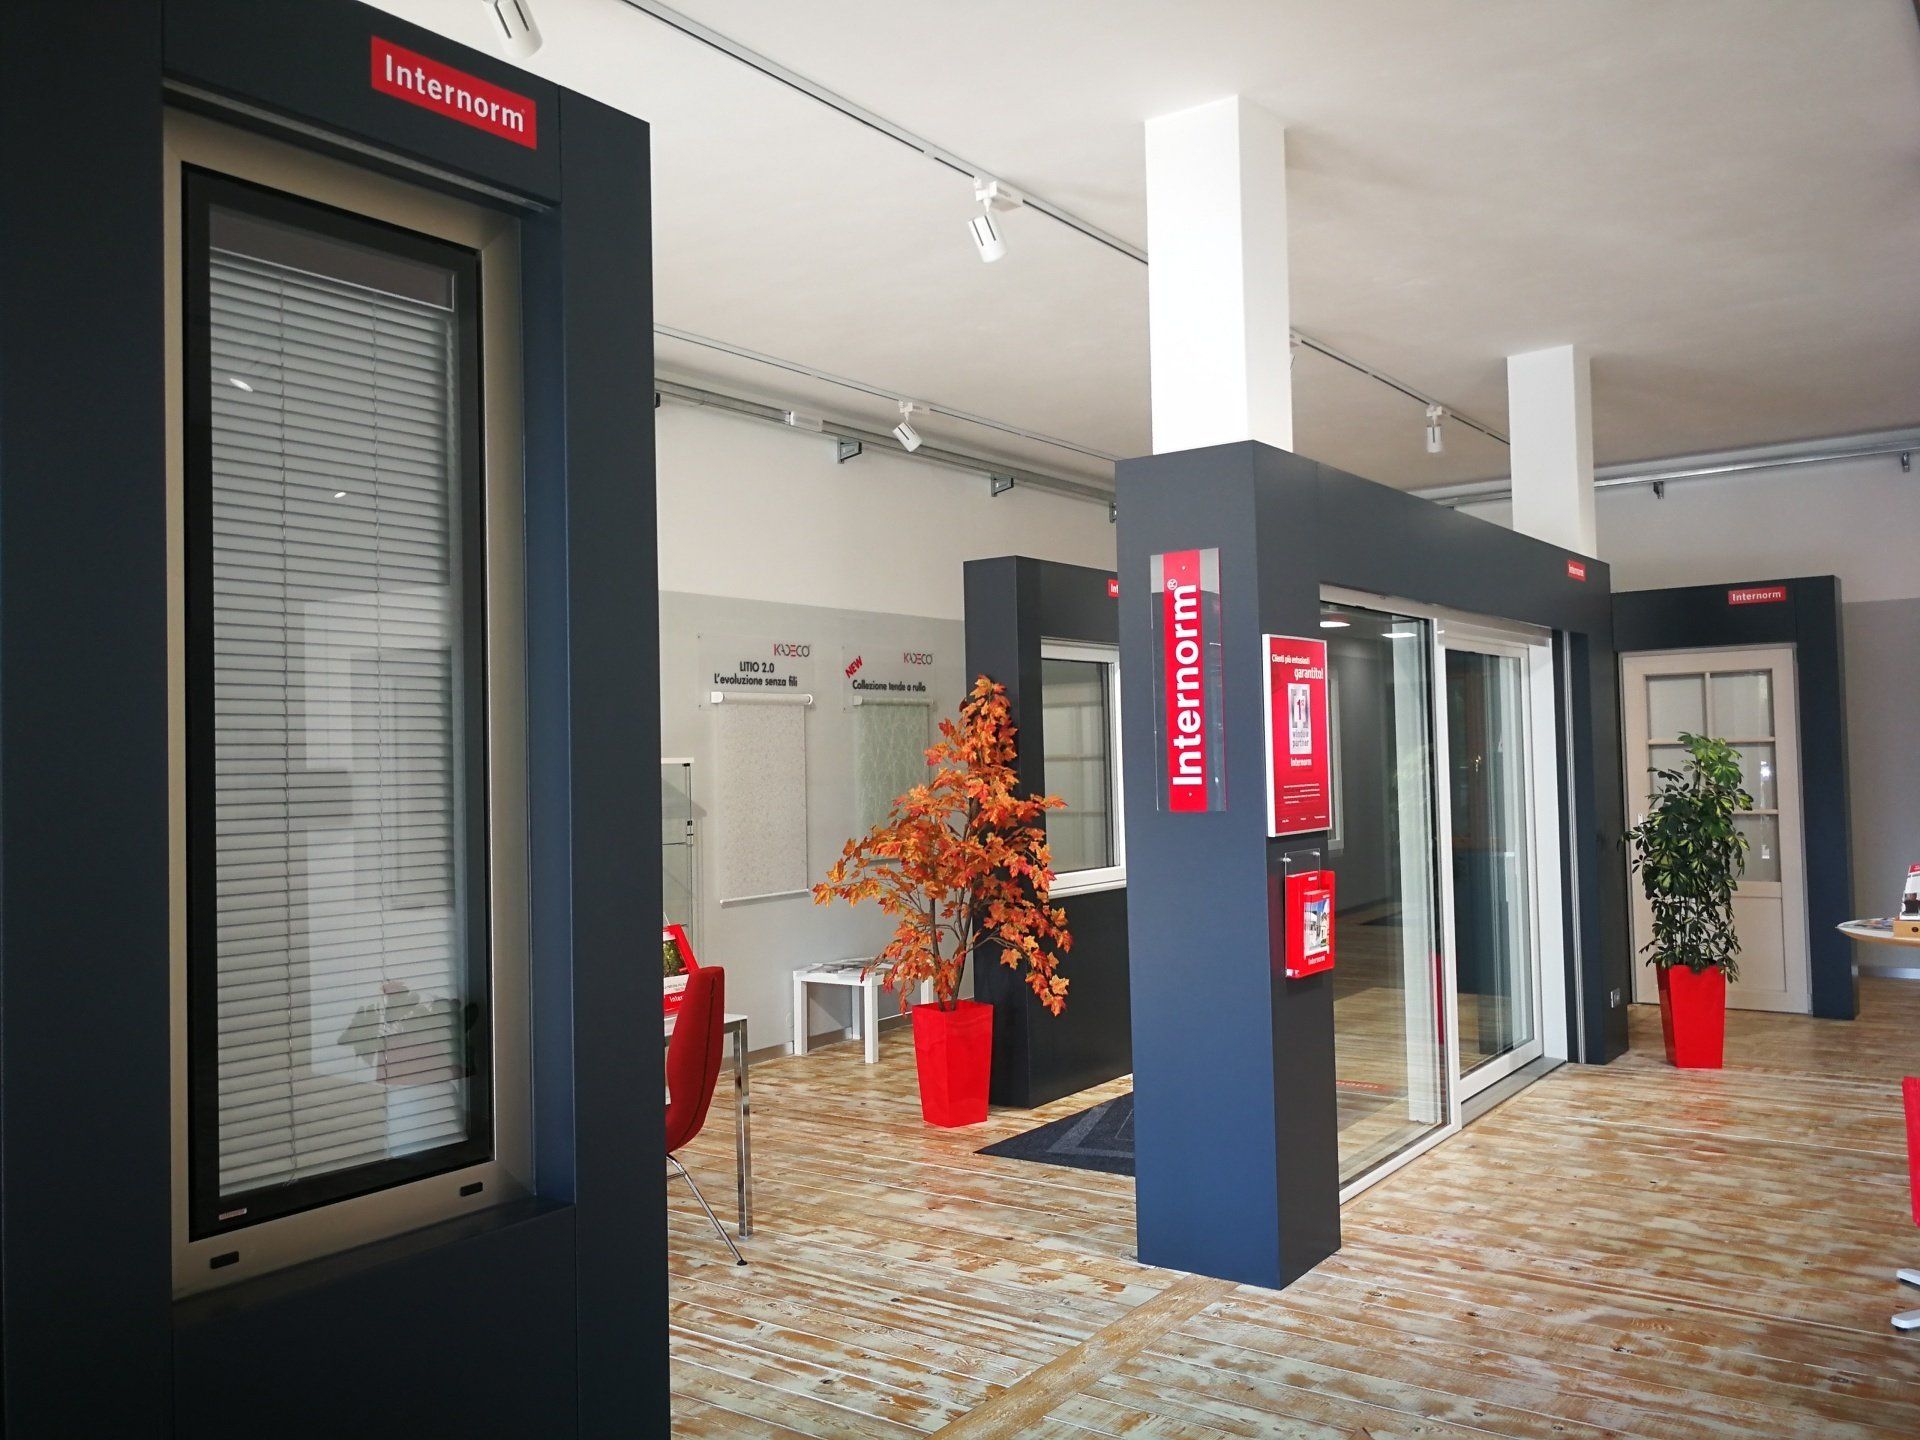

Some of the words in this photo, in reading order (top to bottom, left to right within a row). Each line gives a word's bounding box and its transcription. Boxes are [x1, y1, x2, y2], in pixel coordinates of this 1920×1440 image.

[386, 54, 524, 132] Internorm
[1732, 591, 1782, 602] Internorm
[740, 661, 760, 672] LITIO
[762, 662, 775, 673] 2.0
[845, 656, 863, 678] NEW
[714, 673, 763, 686] L'evoluzione
[765, 678, 787, 686] senza
[789, 675, 798, 687] fili
[852, 679, 887, 691] Collezione
[889, 681, 906, 691] tende
[913, 682, 927, 692] rullo
